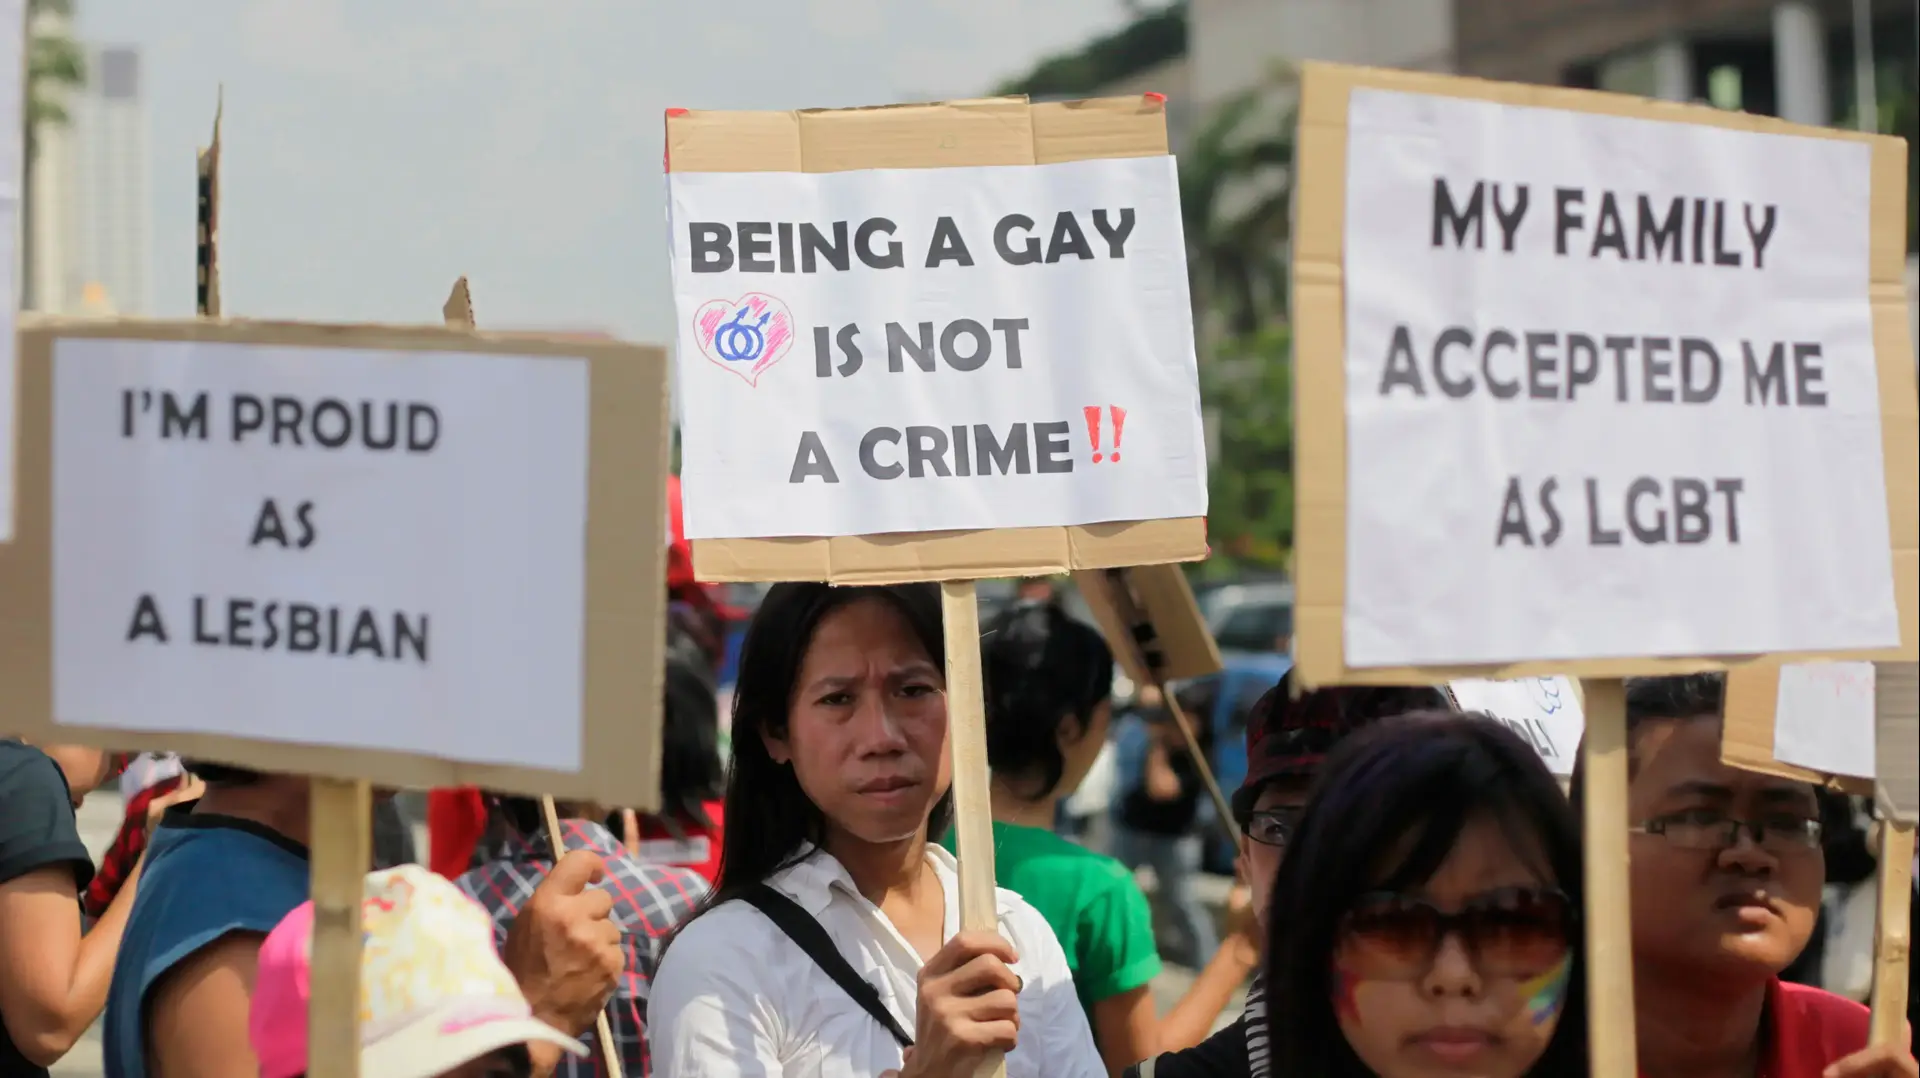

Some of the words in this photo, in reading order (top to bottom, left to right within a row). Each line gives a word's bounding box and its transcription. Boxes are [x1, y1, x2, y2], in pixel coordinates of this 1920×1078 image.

[688, 217, 905, 274] BEING
[924, 216, 975, 269] A
[993, 207, 1136, 266] GAY
[1431, 177, 1529, 253] MY
[1555, 187, 1777, 269] FAMILY
[813, 322, 864, 378] IS
[884, 317, 1030, 373] NOT
[1379, 323, 1722, 404] ACCEPTED
[1741, 340, 1828, 407] ME
[122, 389, 209, 442] I'M
[231, 393, 440, 453] PROUD
[788, 430, 840, 484] A
[250, 498, 316, 550] AS
[1495, 476, 1563, 548] AS
[1585, 476, 1743, 547] LGBT
[126, 594, 168, 643] A
[193, 596, 429, 664] LESBIAN
